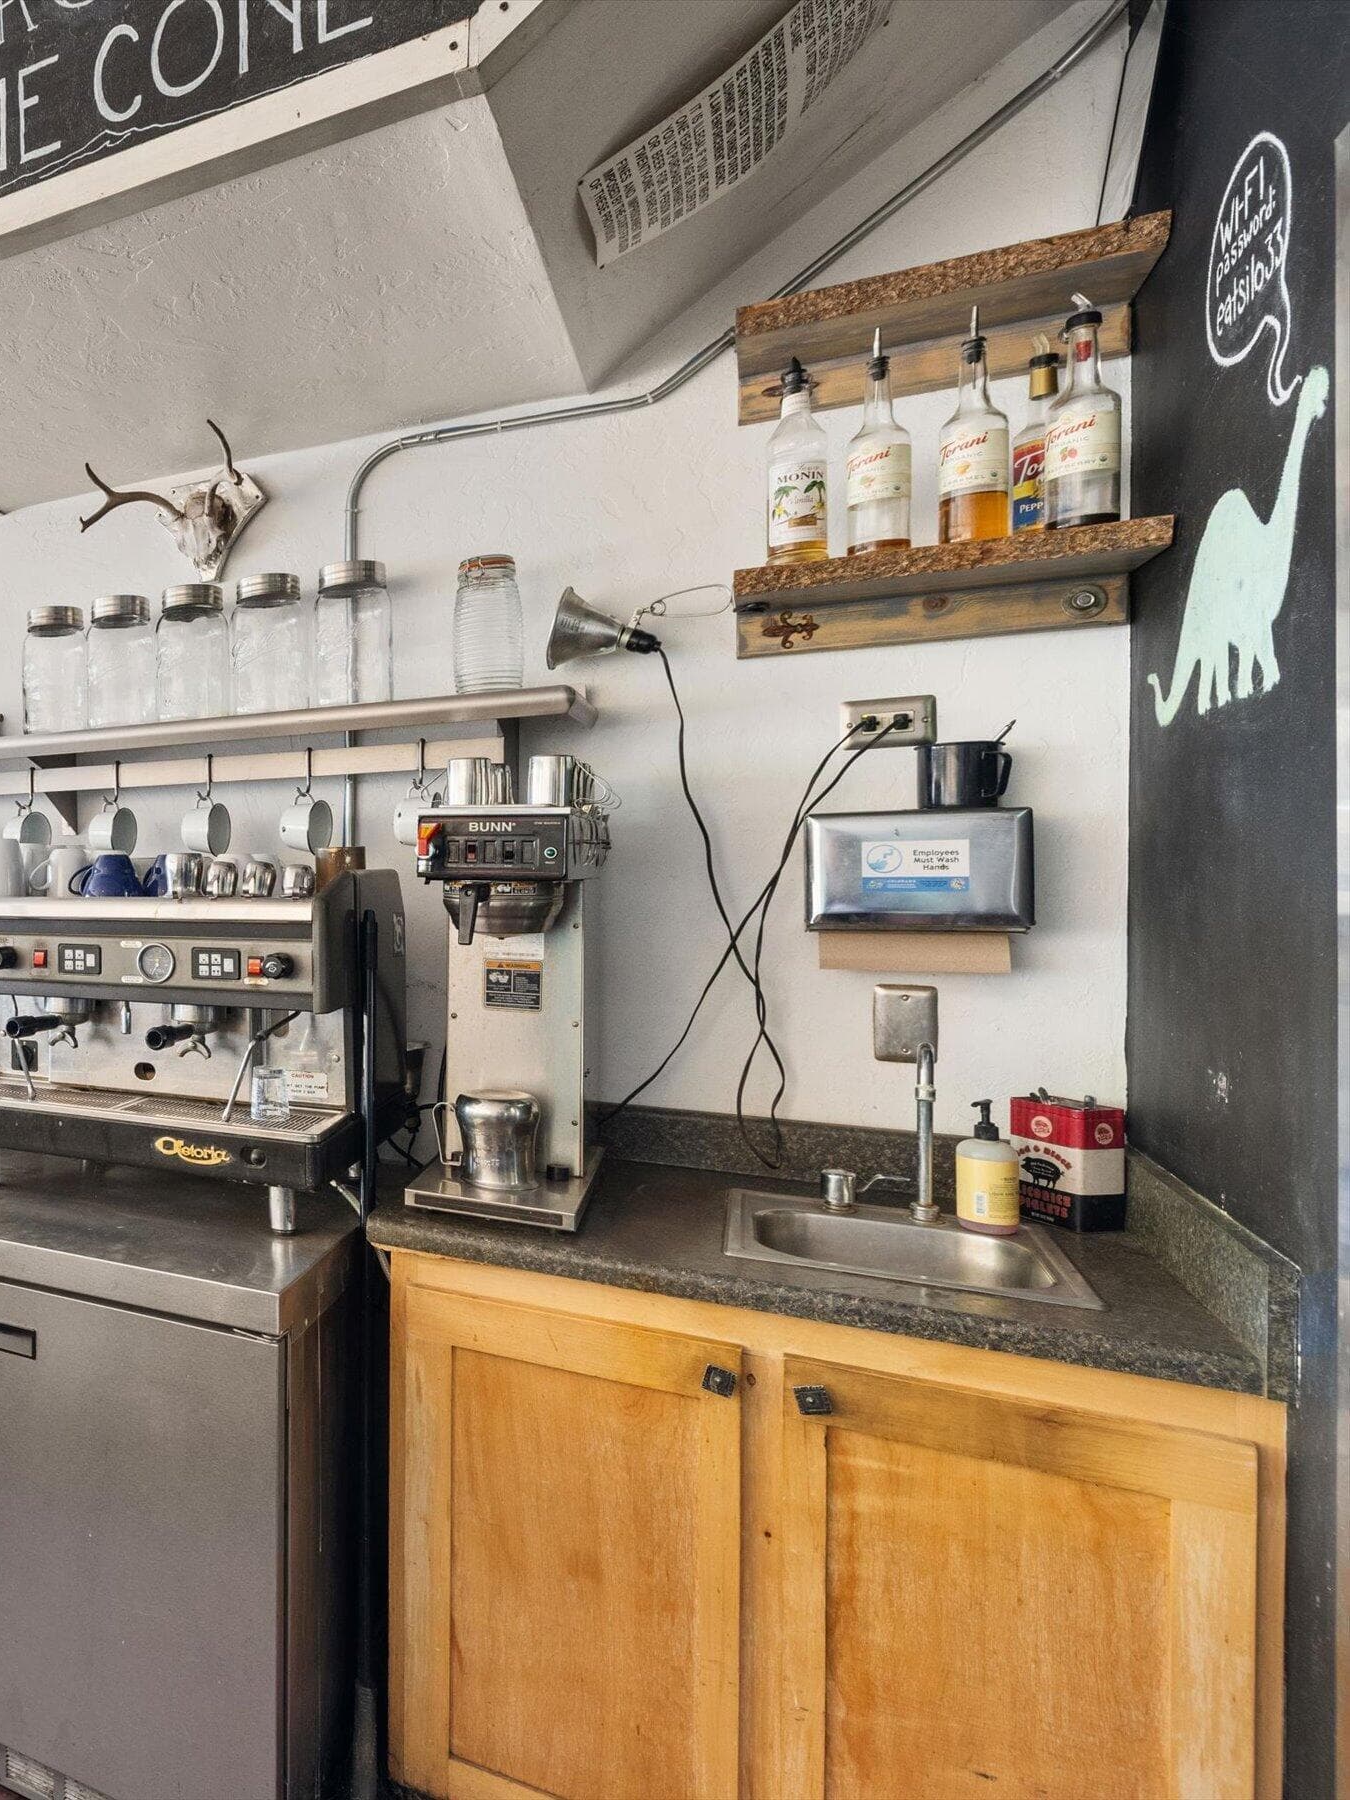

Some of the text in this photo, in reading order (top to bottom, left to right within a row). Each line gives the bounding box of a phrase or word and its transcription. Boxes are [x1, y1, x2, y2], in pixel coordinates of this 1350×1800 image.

[1045, 414, 1097, 452] Torani
[939, 431, 989, 467] Torani
[847, 446, 891, 481] Torani
[777, 470, 825, 485] MONIN
[1019, 501, 1044, 514] PEPP
[468, 821, 512, 832] BUNN
[912, 848, 960, 857] Employees
[923, 863, 950, 871] Hands
[1020, 1183, 1072, 1208] ICORICE
[1020, 1195, 1068, 1218] IGLETS
